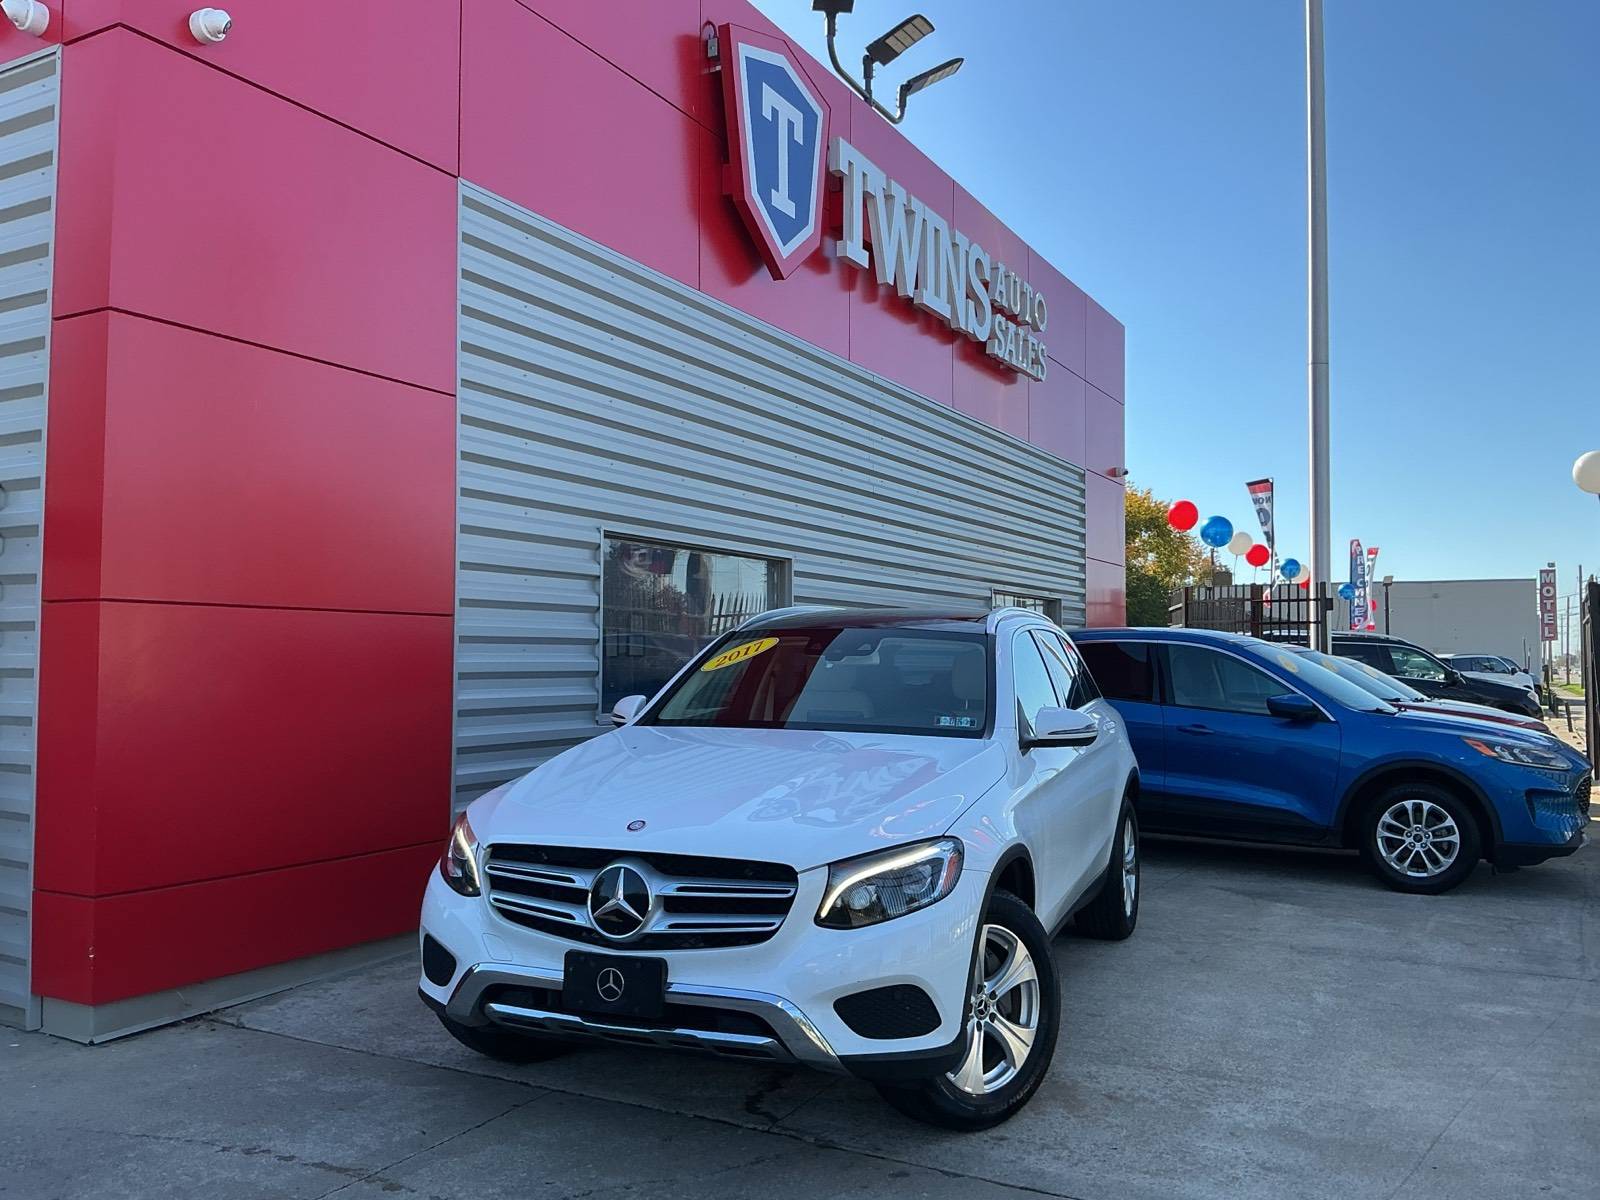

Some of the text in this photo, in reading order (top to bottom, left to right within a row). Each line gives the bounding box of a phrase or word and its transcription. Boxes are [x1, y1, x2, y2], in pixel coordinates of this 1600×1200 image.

[762, 81, 803, 219] T
[829, 136, 993, 342] TWINS
[989, 262, 1048, 332] AUTO
[986, 313, 1048, 382] SALES
[1541, 572, 1554, 637] MOTEL
[715, 640, 765, 667] 2017
